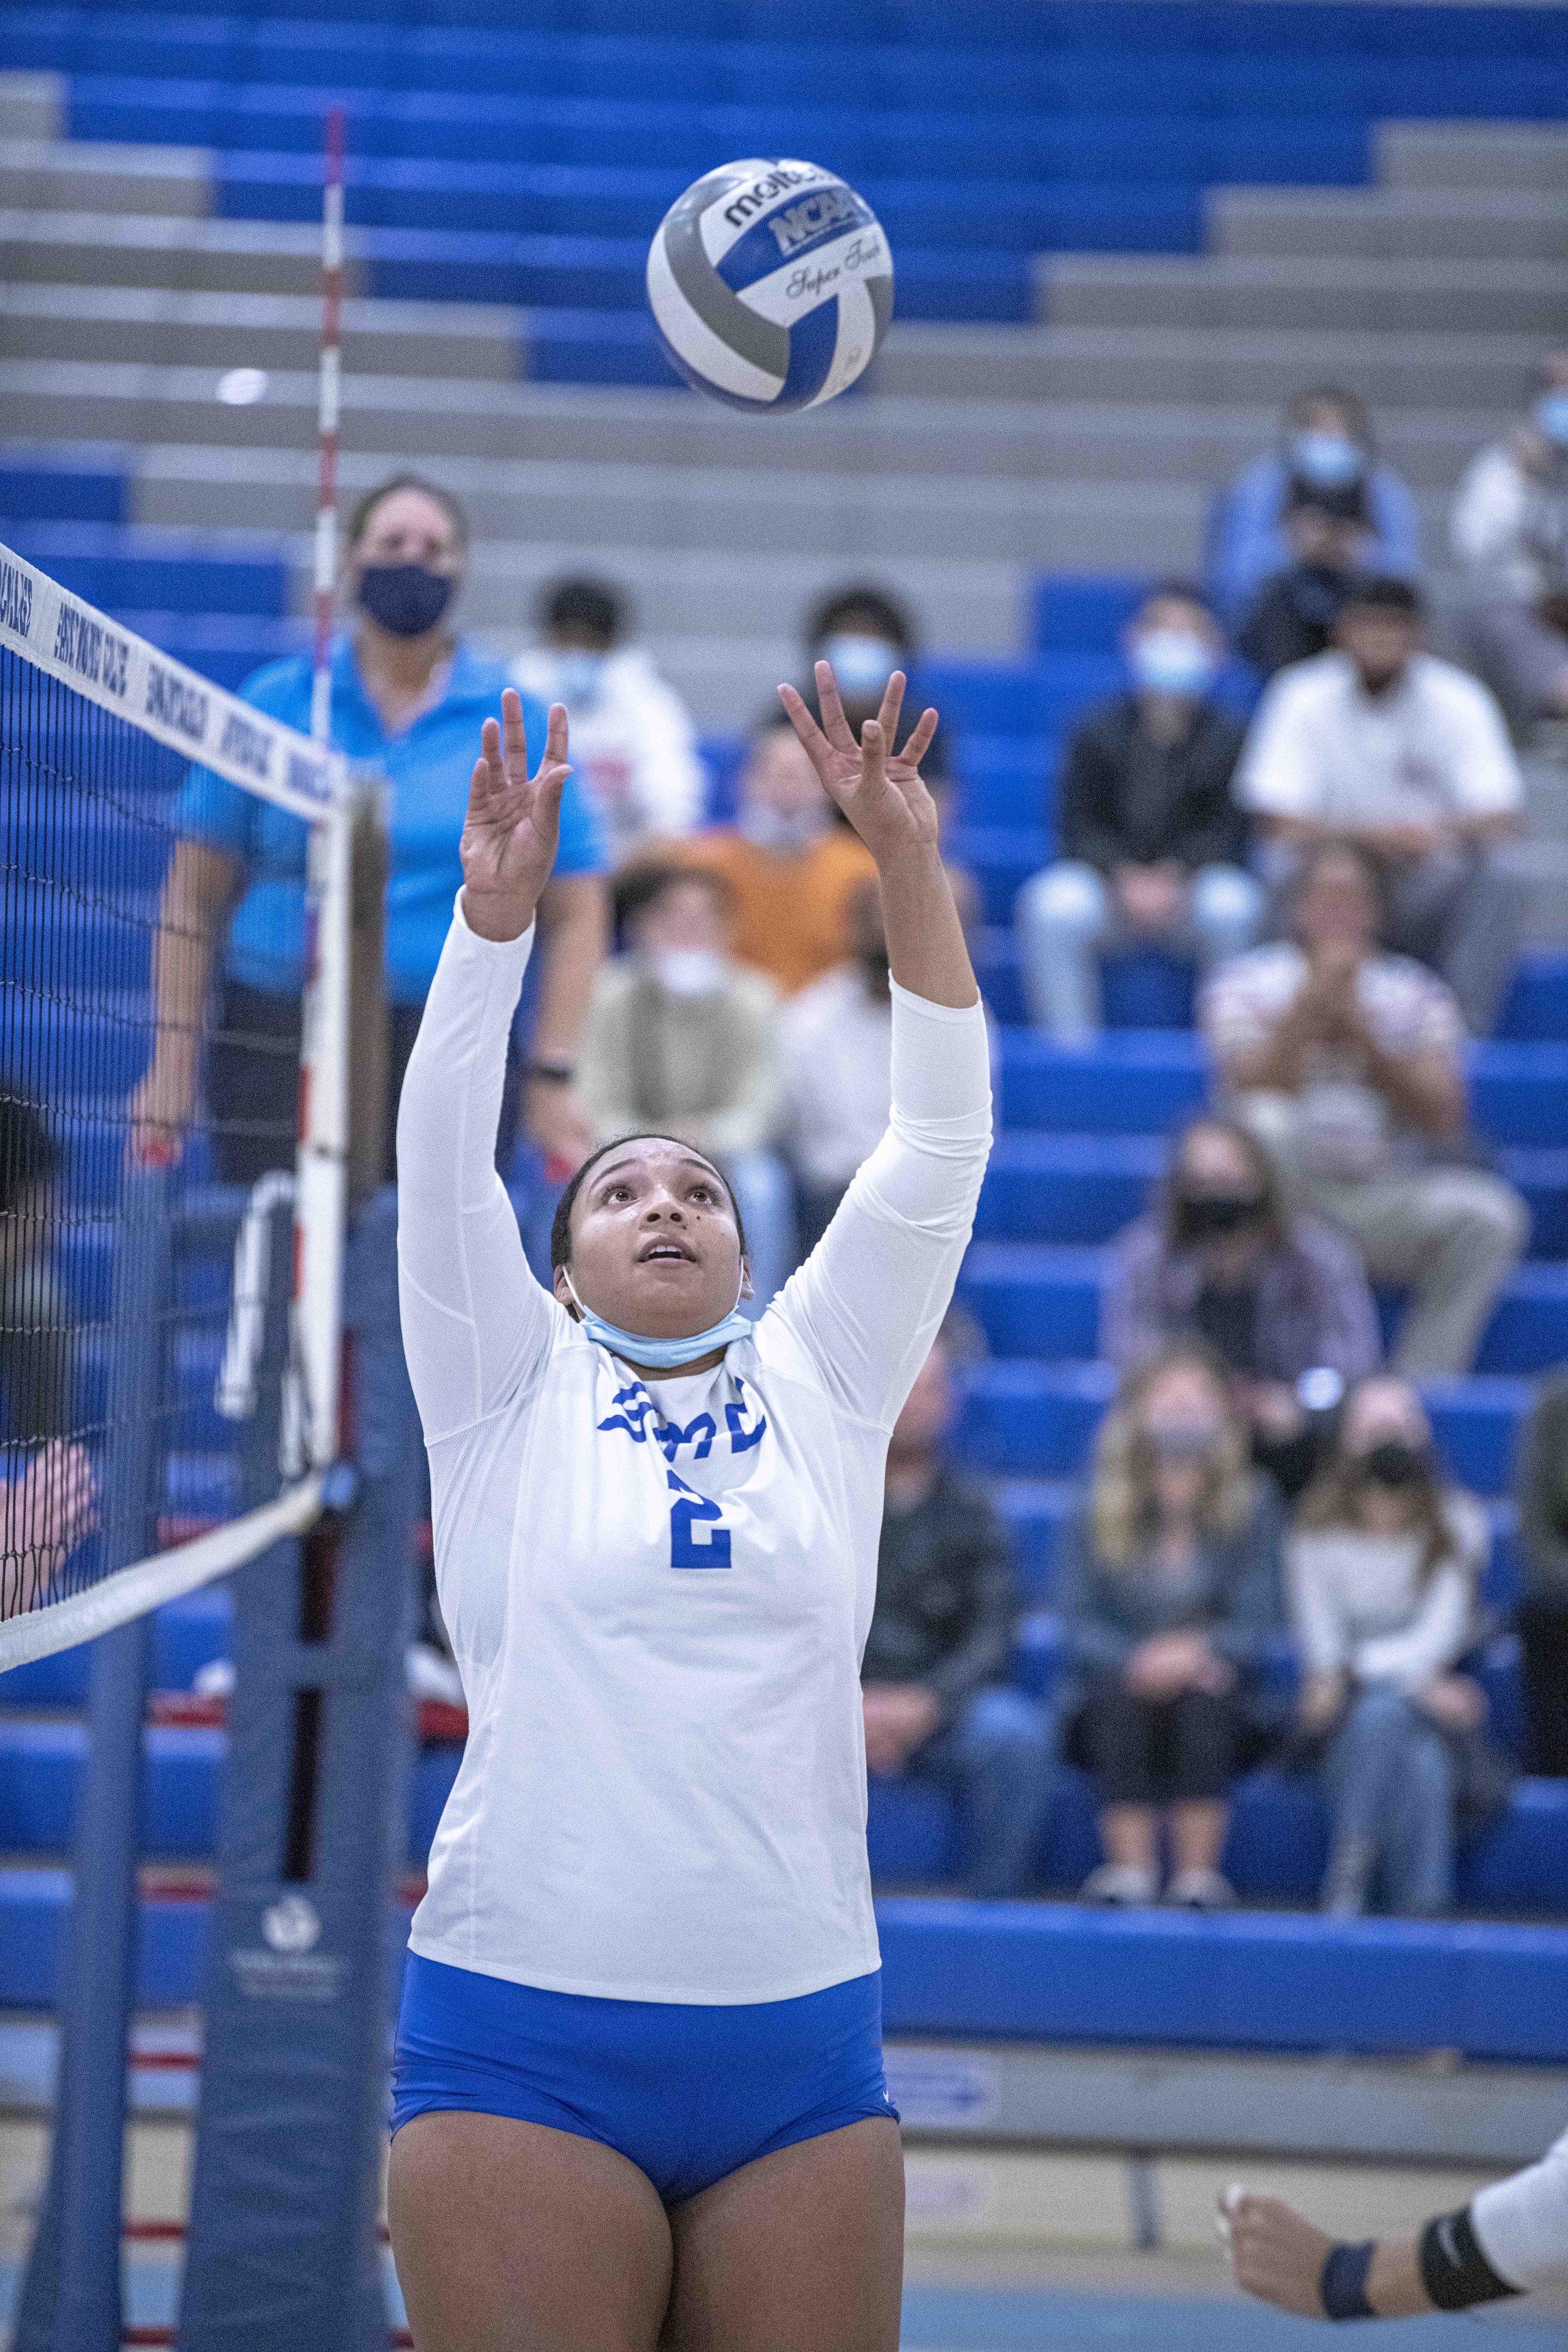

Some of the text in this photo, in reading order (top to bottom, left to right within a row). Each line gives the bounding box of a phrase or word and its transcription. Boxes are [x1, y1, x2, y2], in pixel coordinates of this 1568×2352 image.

[724, 168, 827, 228] molt
[785, 265, 841, 299] Super
[666, 1469, 732, 1569] 2
